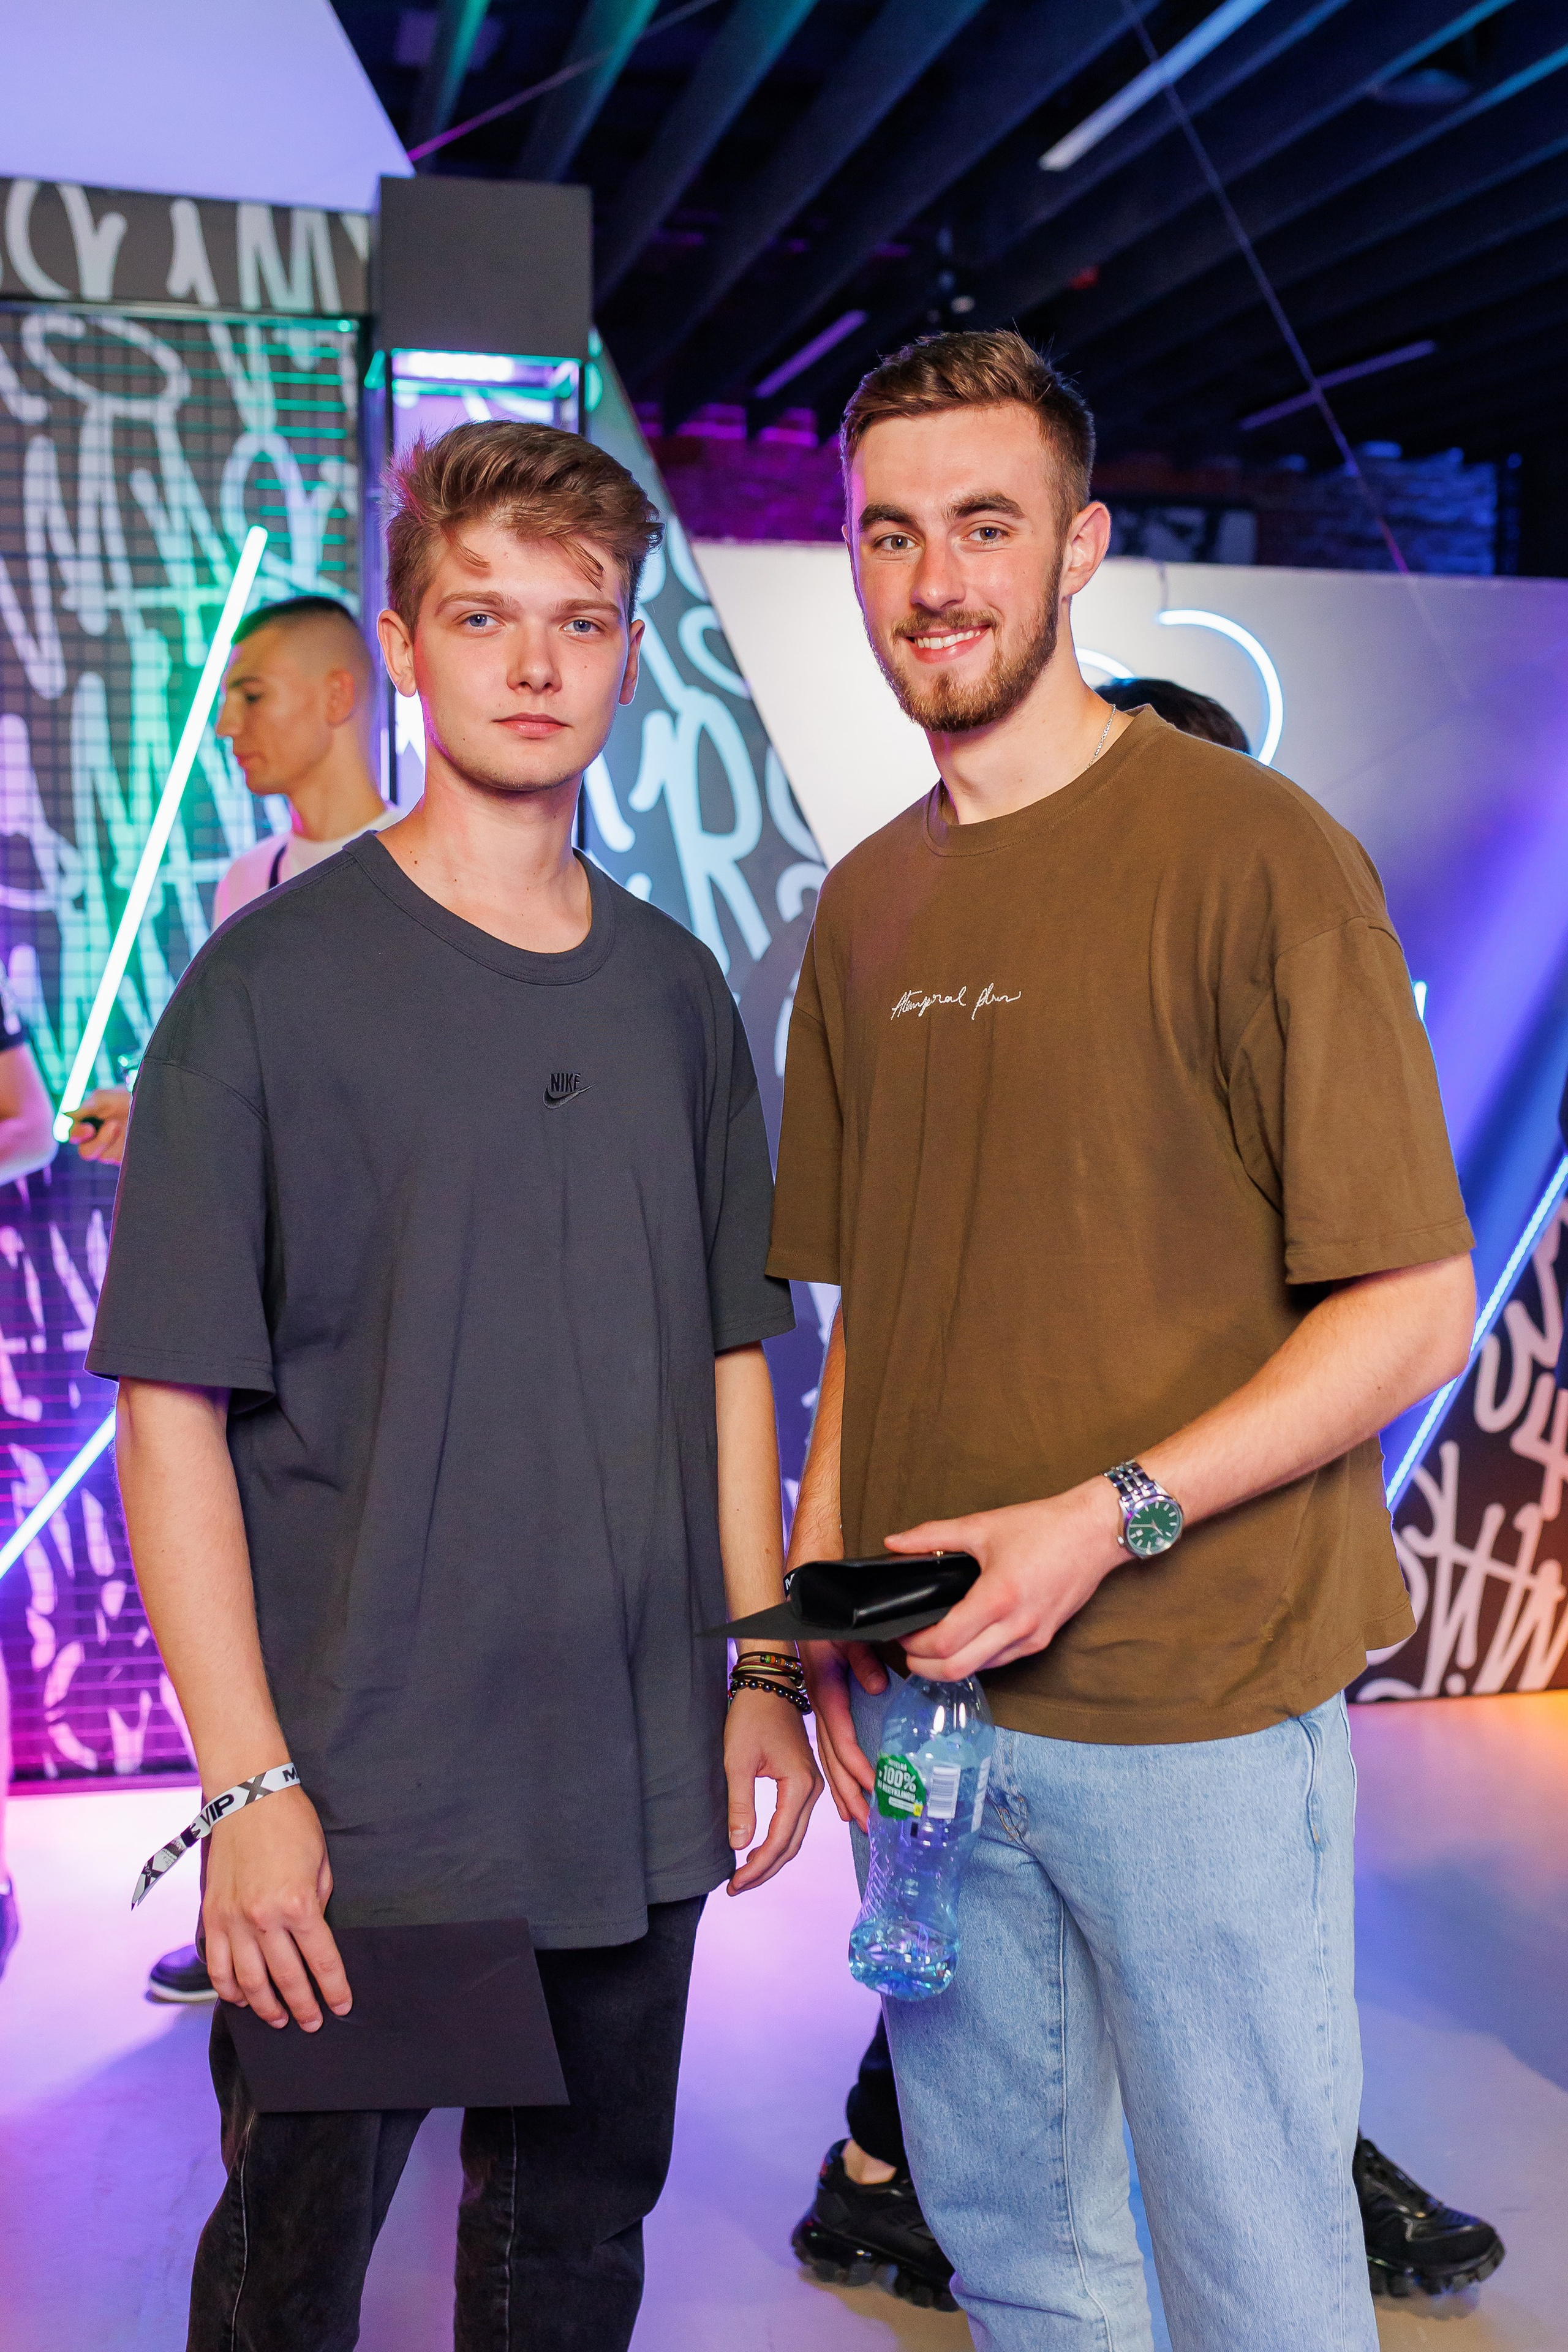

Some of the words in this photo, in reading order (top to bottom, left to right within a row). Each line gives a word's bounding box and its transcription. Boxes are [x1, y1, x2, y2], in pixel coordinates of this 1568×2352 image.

[551, 1072, 581, 1092] NIKE
[883, 1764, 916, 1793] 100%
[200, 1793, 235, 1827] VIP
